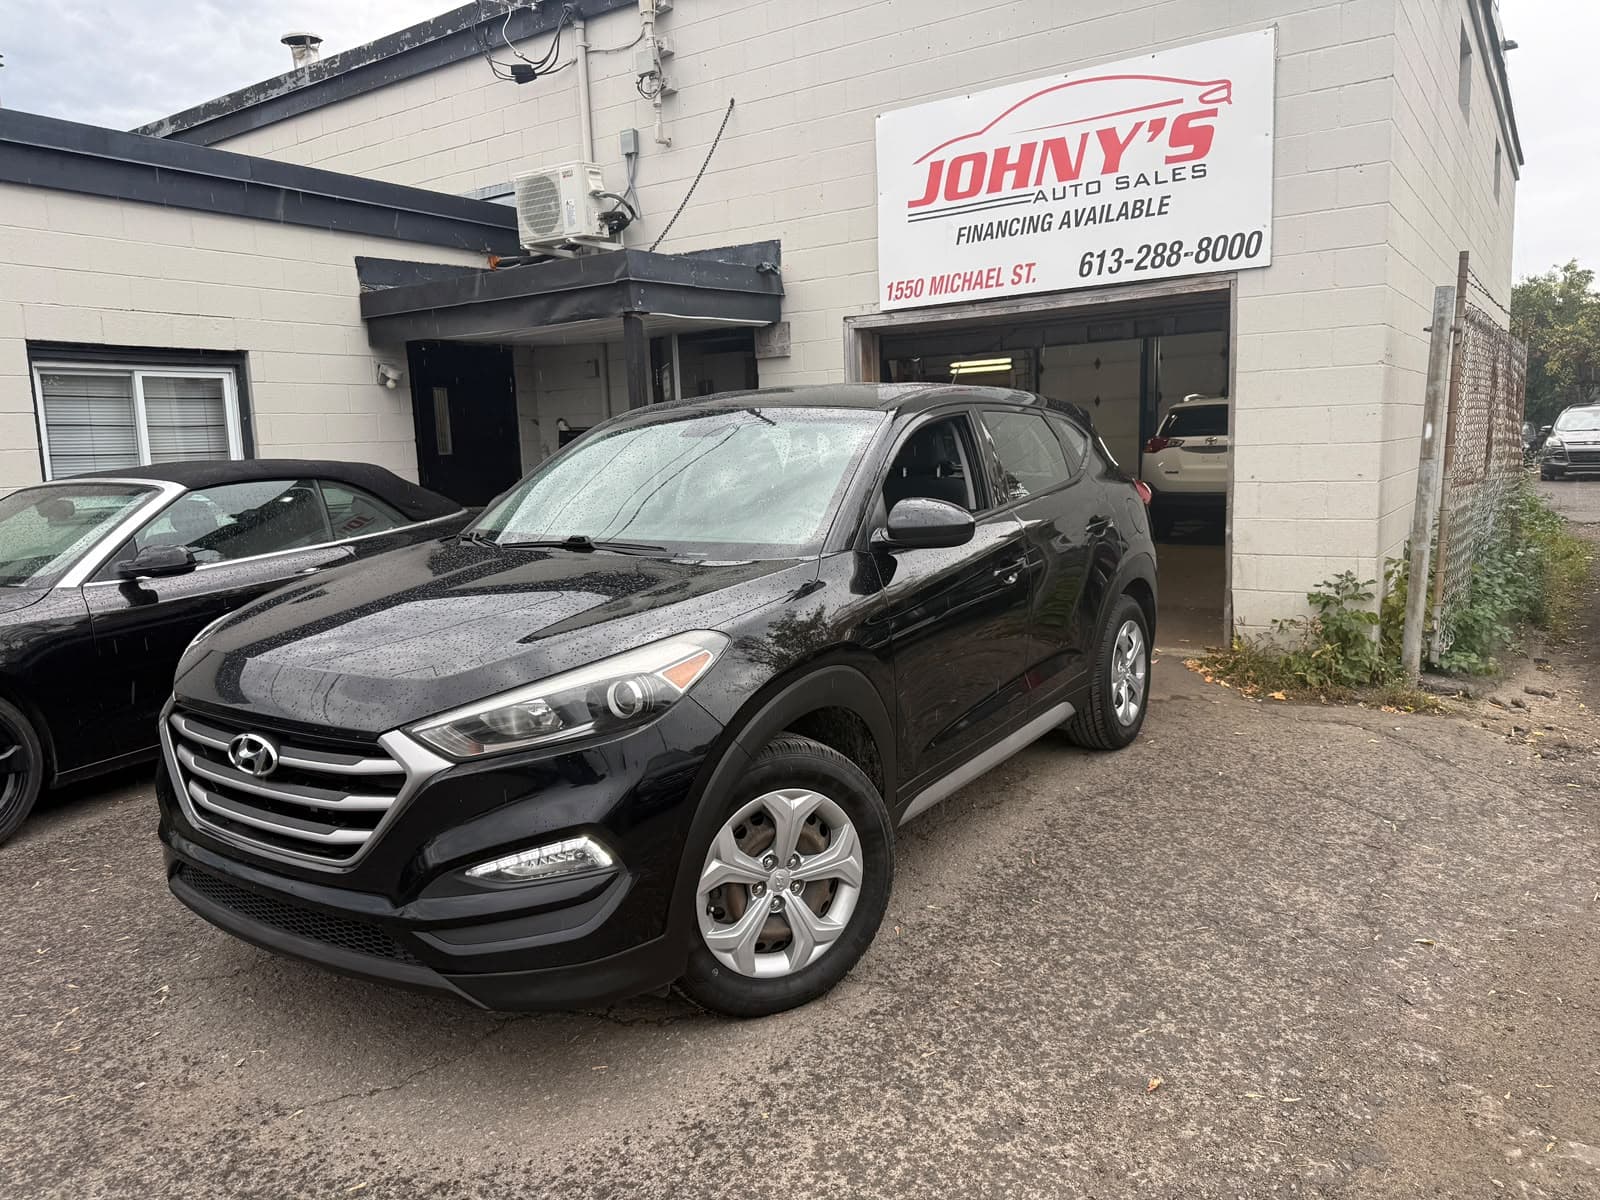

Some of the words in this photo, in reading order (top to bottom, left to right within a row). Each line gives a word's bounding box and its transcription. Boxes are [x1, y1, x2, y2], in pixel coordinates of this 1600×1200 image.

[907, 107, 1218, 209] JOHNY'S
[1032, 180, 1101, 204] AUTO
[1115, 163, 1207, 190] SALES
[956, 212, 1053, 245] FINANCING
[1058, 195, 1171, 230] AVAILABLE
[1078, 230, 1263, 278] 613-288-8000
[886, 277, 924, 301] 1550
[929, 267, 1005, 295] MICHAEL
[1010, 262, 1037, 285] ST.
